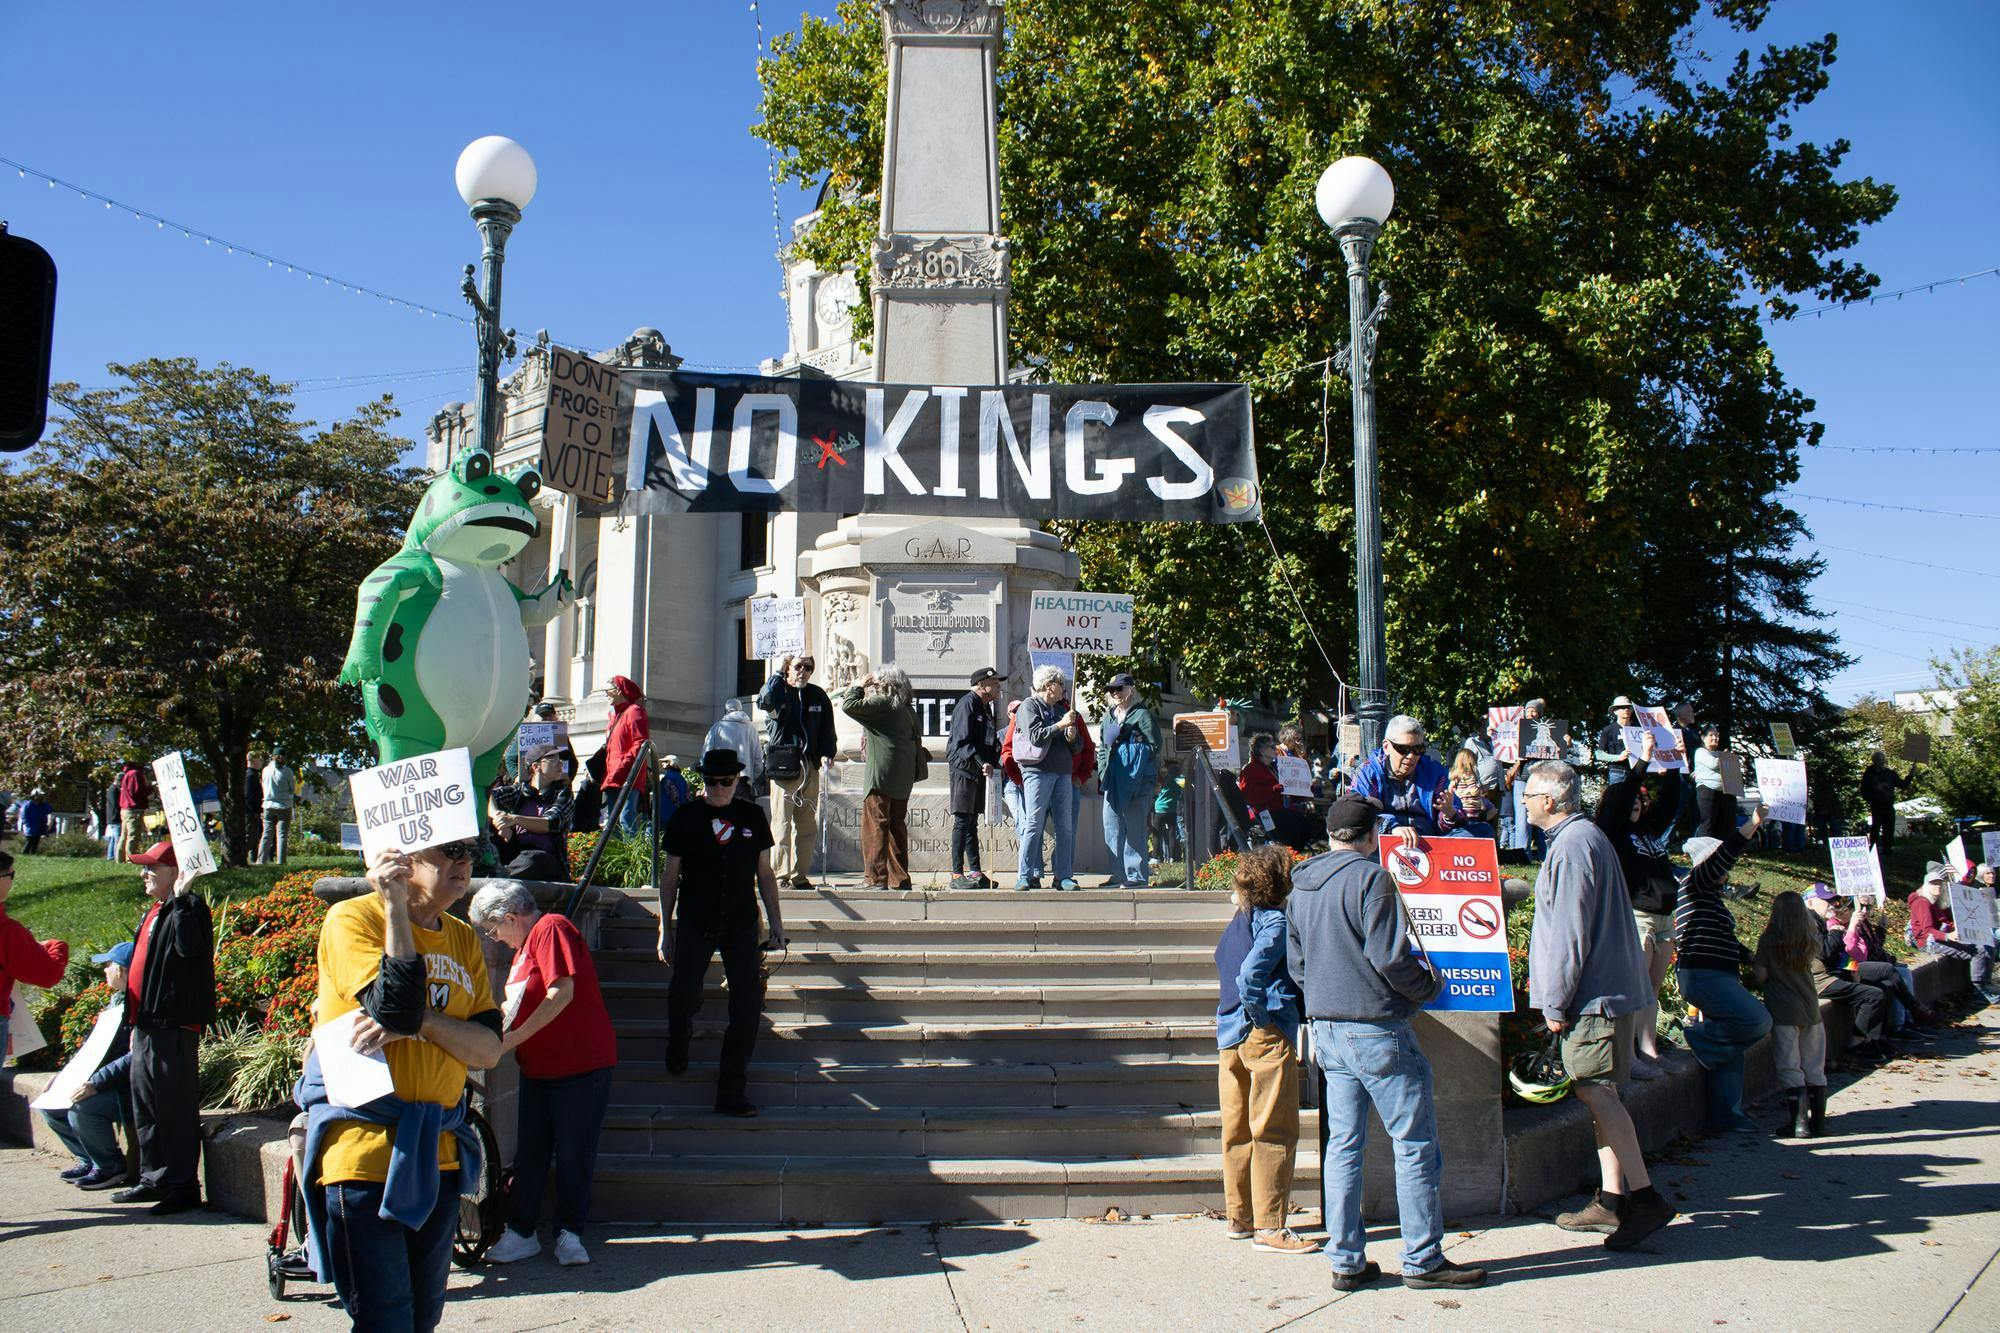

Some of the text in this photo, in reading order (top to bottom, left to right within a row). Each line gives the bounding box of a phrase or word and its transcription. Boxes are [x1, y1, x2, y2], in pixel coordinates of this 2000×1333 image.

[917, 250, 964, 278] 1861
[550, 384, 617, 421] FROGET
[563, 414, 602, 446] TO
[625, 386, 1214, 500] NO KINGS
[543, 438, 612, 499] VOTE
[1034, 597, 1134, 614] HEALTHCARE
[956, 615, 973, 628] POST
[1066, 615, 1101, 629] NOT
[757, 631, 778, 641] OUR
[1035, 636, 1114, 651] WARFARE
[520, 725, 550, 735] BE THE
[377, 758, 439, 789] WAR
[364, 784, 465, 830] KILLING
[1453, 855, 1475, 867] NO
[1439, 870, 1492, 882] KINGS!
[1441, 968, 1502, 980] NESSUN
[1450, 984, 1495, 996] DUCE!
